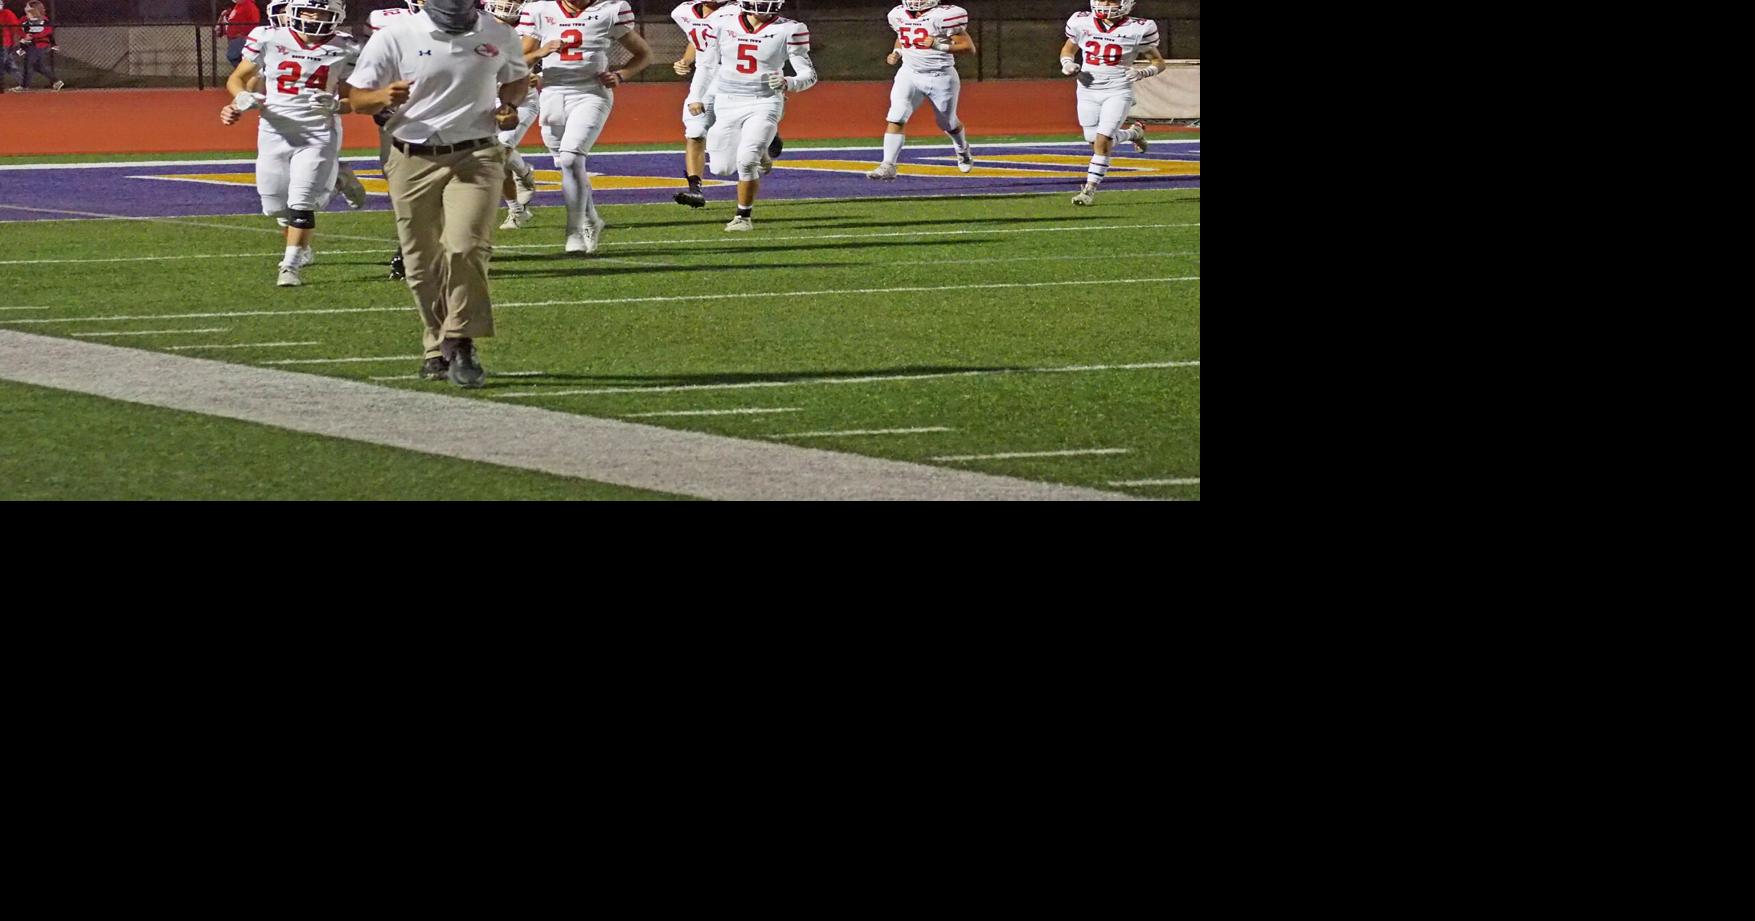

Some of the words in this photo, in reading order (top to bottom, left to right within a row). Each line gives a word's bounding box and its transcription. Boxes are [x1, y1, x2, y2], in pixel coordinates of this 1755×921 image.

[560, 29, 583, 61] 2
[899, 27, 929, 49] 52
[736, 44, 758, 74] 5
[1085, 41, 1122, 66] 20
[277, 61, 330, 95] 24
